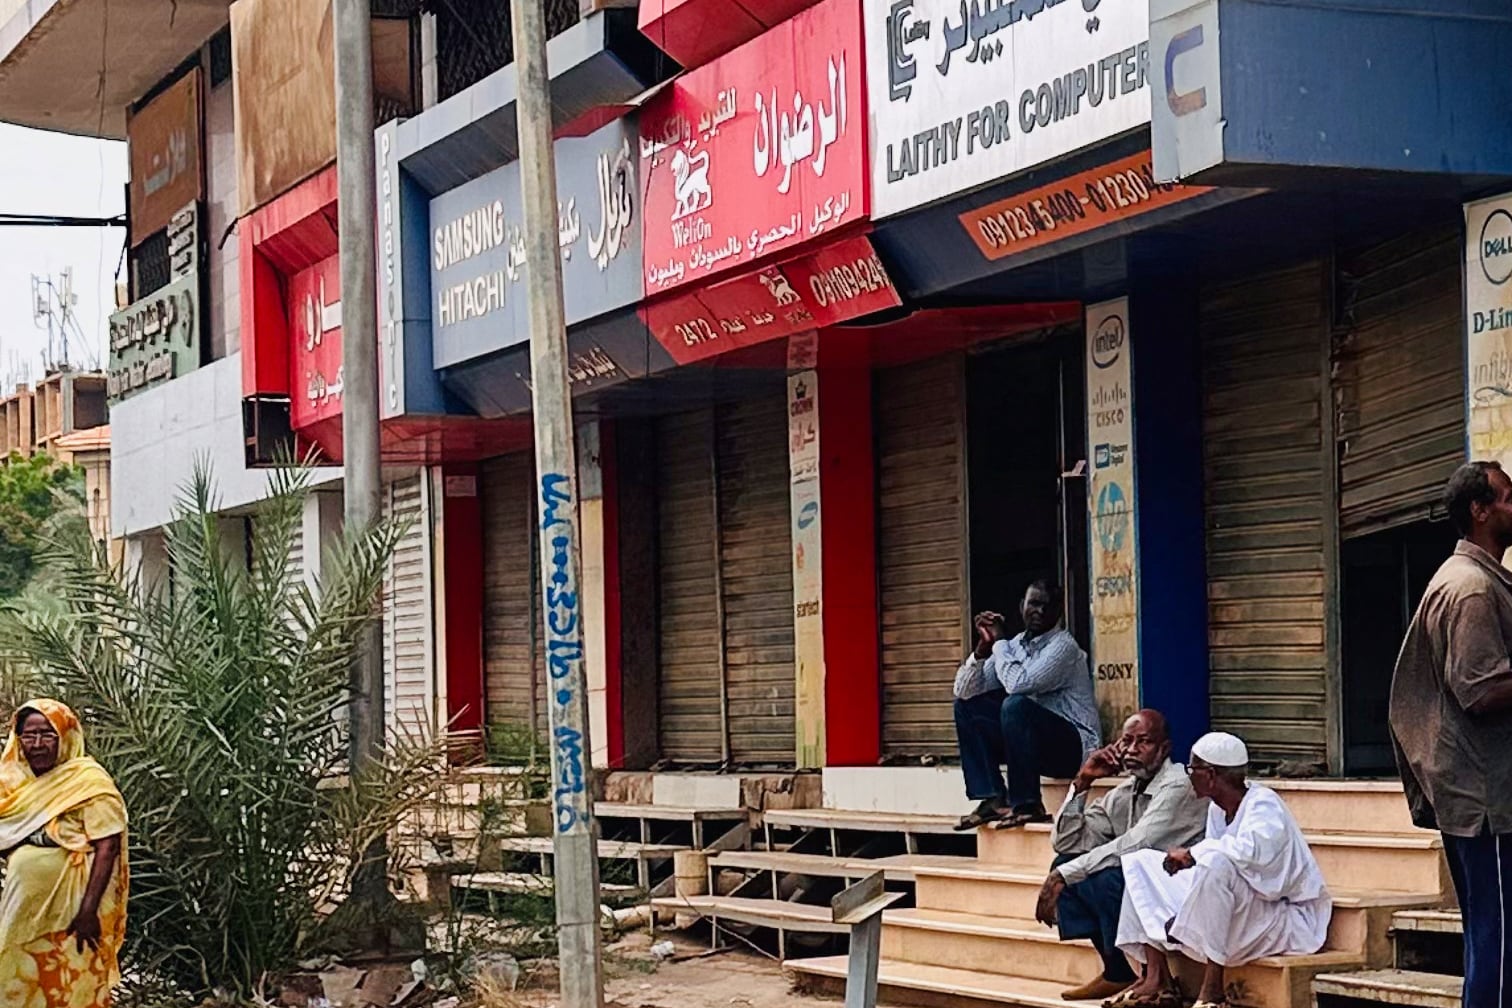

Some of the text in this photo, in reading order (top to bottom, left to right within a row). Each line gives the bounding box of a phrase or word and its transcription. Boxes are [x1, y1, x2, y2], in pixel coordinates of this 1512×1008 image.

[697, 86, 737, 143] للتبريد
[753, 50, 848, 195] الرضوان
[886, 117, 962, 184] LAITHY
[967, 100, 1010, 155] FOR
[434, 200, 505, 272] SAMSUNG
[671, 217, 712, 249] WeliOn
[746, 211, 803, 258] الحصري
[808, 191, 850, 235] الوكيل
[380, 132, 399, 410] Panasonic
[689, 235, 743, 270] بالسودان
[438, 271, 506, 329] HITACHI
[674, 317, 718, 347] 2472
[1097, 663, 1134, 681] SONY
